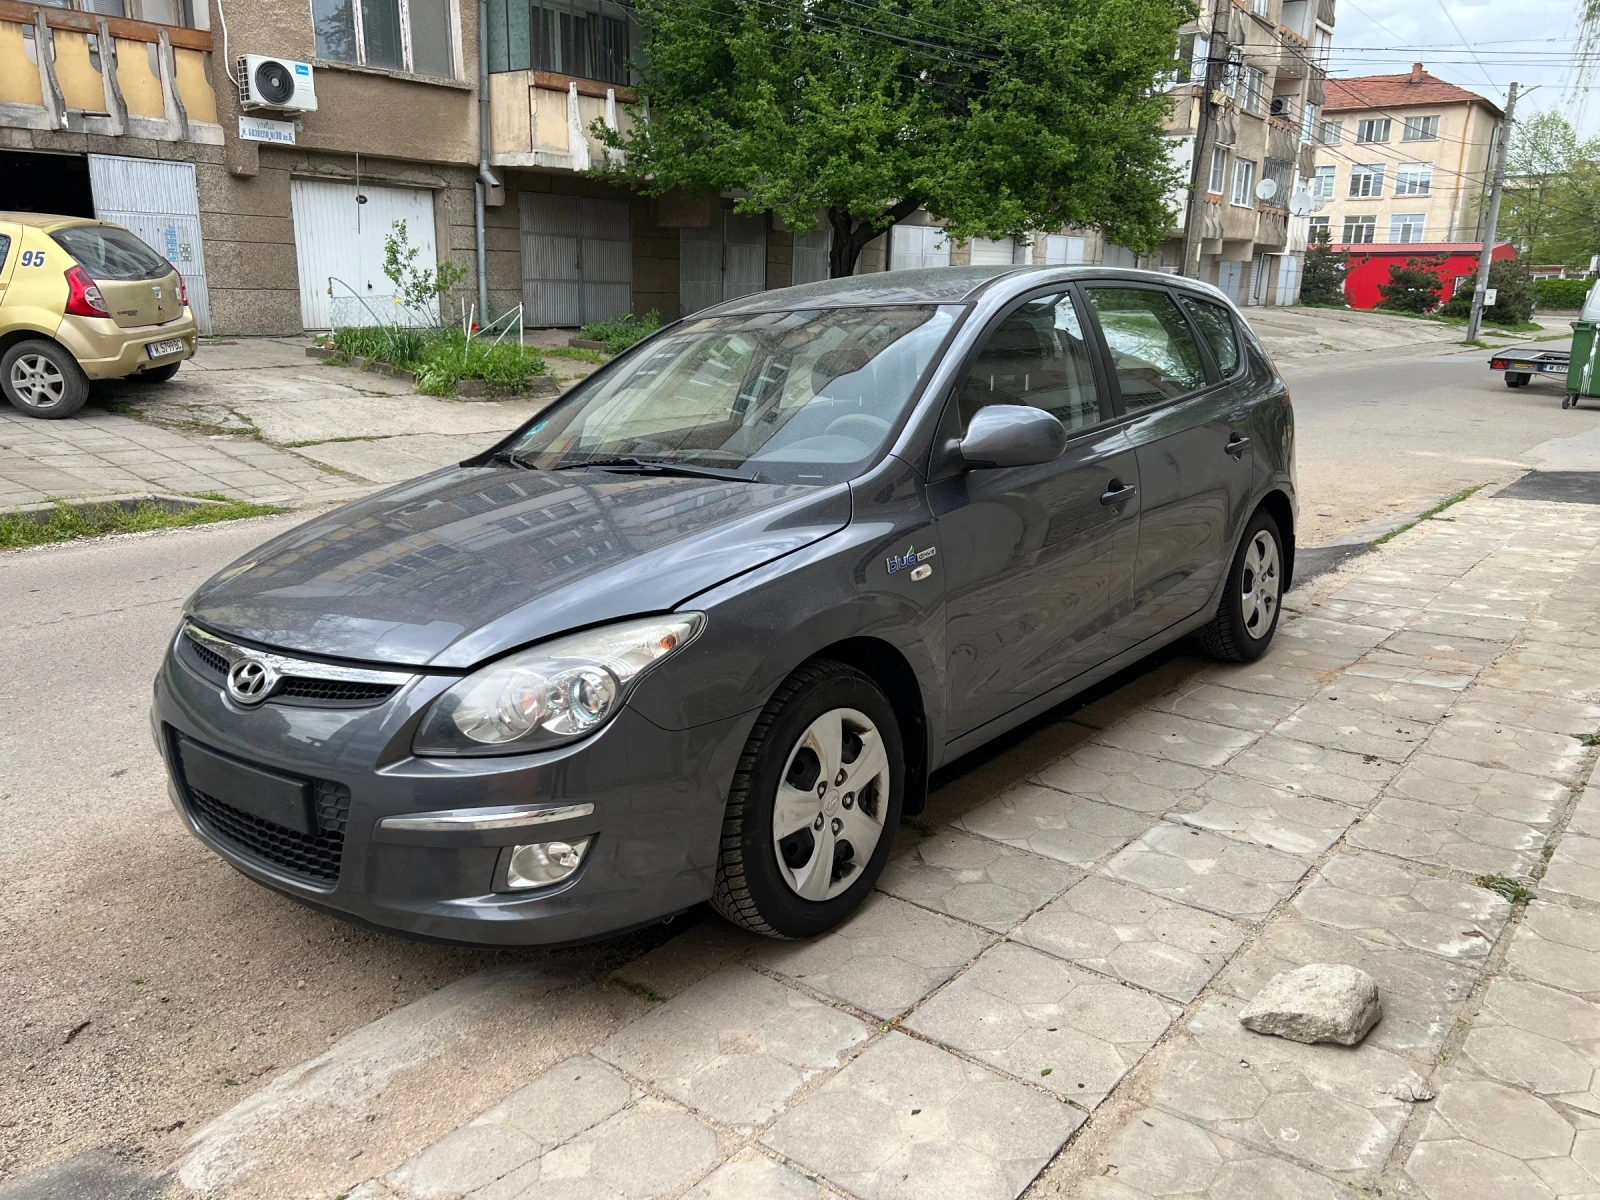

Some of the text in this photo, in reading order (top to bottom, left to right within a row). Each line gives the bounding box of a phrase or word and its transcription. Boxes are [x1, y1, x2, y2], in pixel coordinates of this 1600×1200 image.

[256, 122, 275, 130] улица
[21, 250, 46, 267] 95
[886, 549, 916, 574] blue
